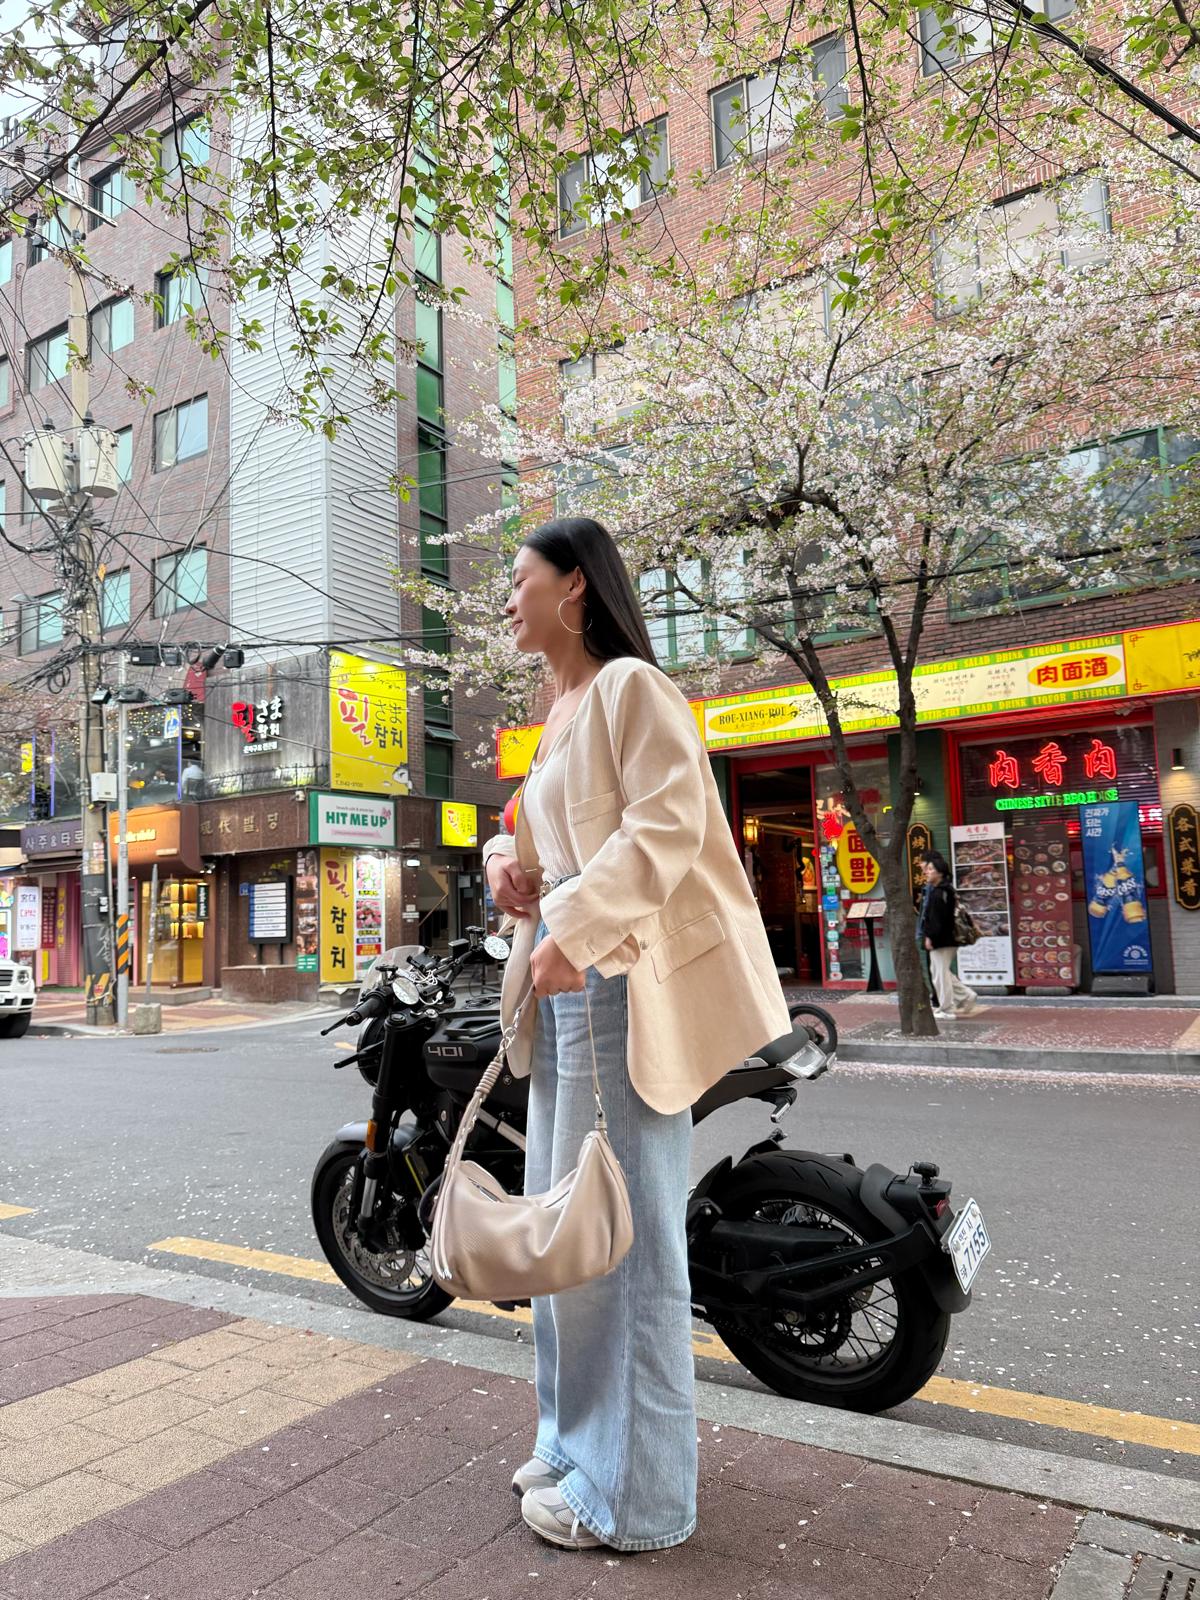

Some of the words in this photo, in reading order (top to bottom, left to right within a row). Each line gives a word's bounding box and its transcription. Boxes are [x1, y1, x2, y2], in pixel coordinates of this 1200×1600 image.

[964, 656, 990, 668] SALAD
[996, 650, 1024, 663] DRINK
[1030, 644, 1063, 657] LIQUOR
[1069, 636, 1116, 651] BEVERAGE
[1036, 657, 1107, 685] 肉面酒
[966, 703, 993, 715] SALAD
[999, 697, 1027, 709] DRINK
[1033, 692, 1067, 706] LIQUOR
[1073, 685, 1121, 700] BEVERAGE
[374, 722, 403, 750] 참치
[989, 739, 1118, 788] 肉香肉
[995, 796, 1034, 811] CHINESE
[1034, 794, 1061, 808] STYLE
[1063, 791, 1087, 806] BBQ
[326, 811, 347, 825] HIT
[350, 813, 368, 827] ME
[371, 815, 388, 828] UP
[1084, 827, 1103, 837] 시간
[427, 1046, 463, 1057] 401
[964, 1224, 986, 1271] 7155
